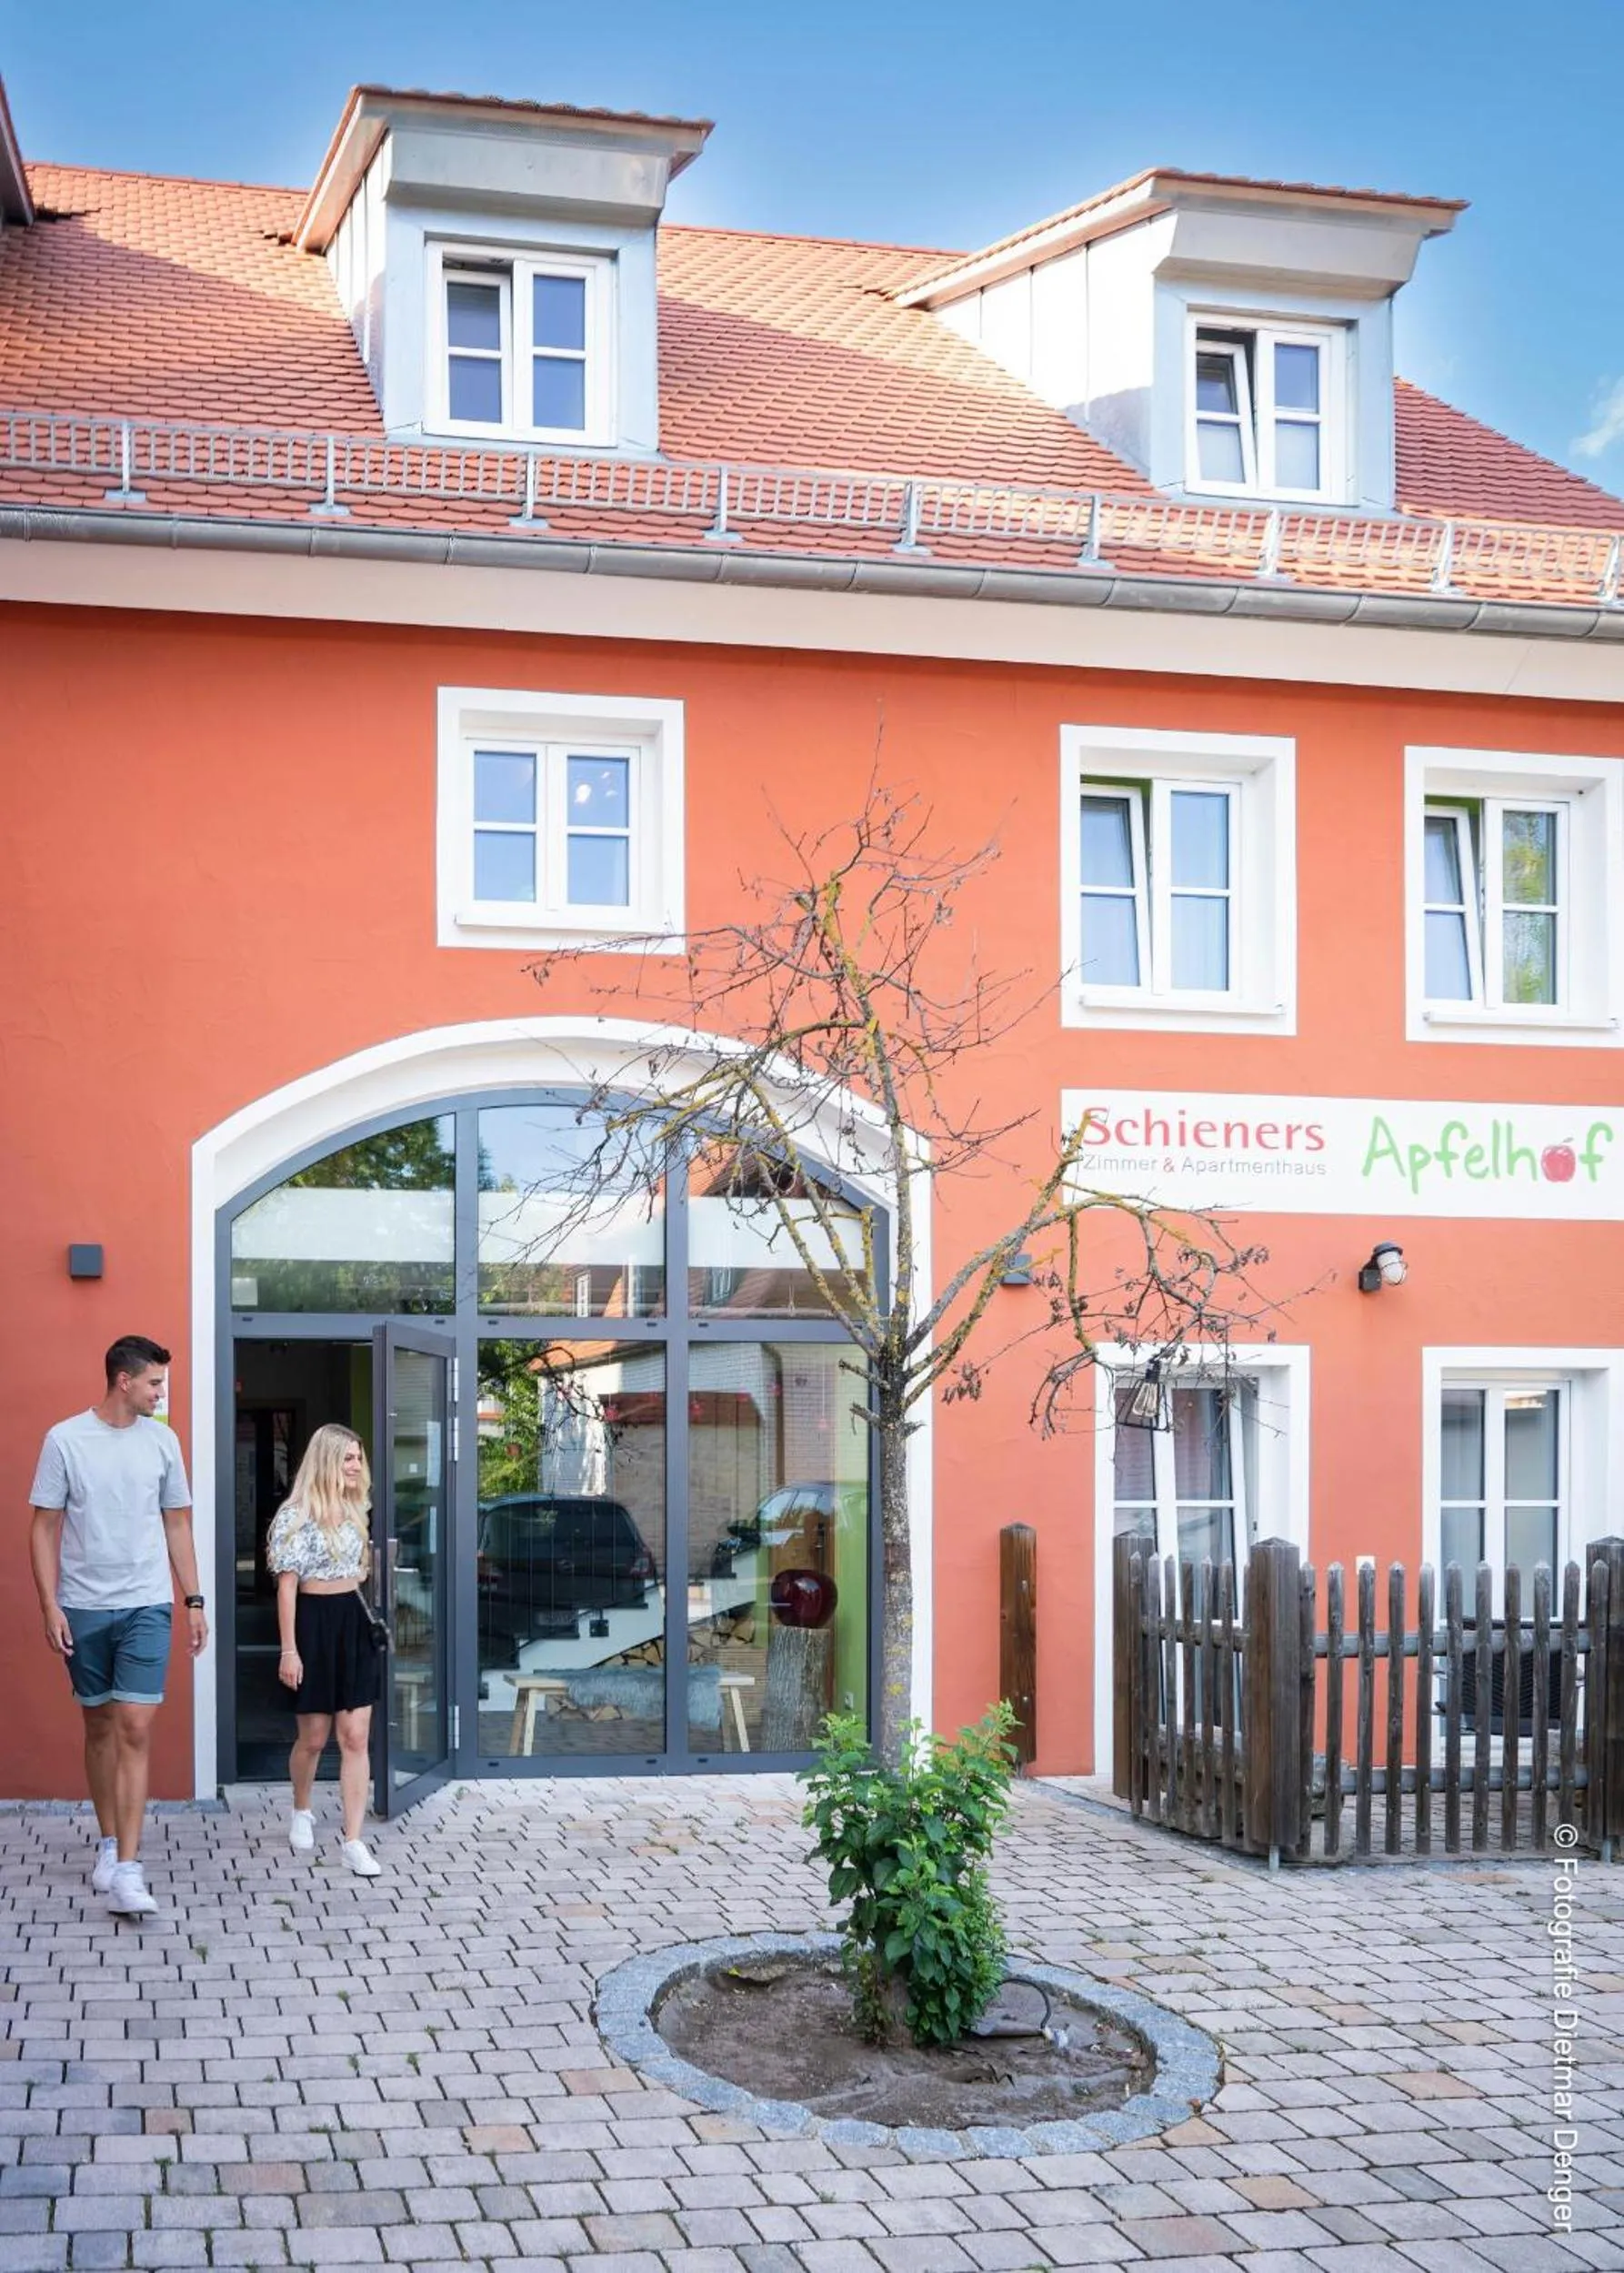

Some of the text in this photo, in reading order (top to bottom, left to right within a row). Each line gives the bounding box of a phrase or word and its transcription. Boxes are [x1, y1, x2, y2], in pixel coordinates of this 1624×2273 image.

[1082, 1106, 1325, 1152] Schieners
[1083, 1152, 1328, 1176] Zimmer & Apartmenthaus
